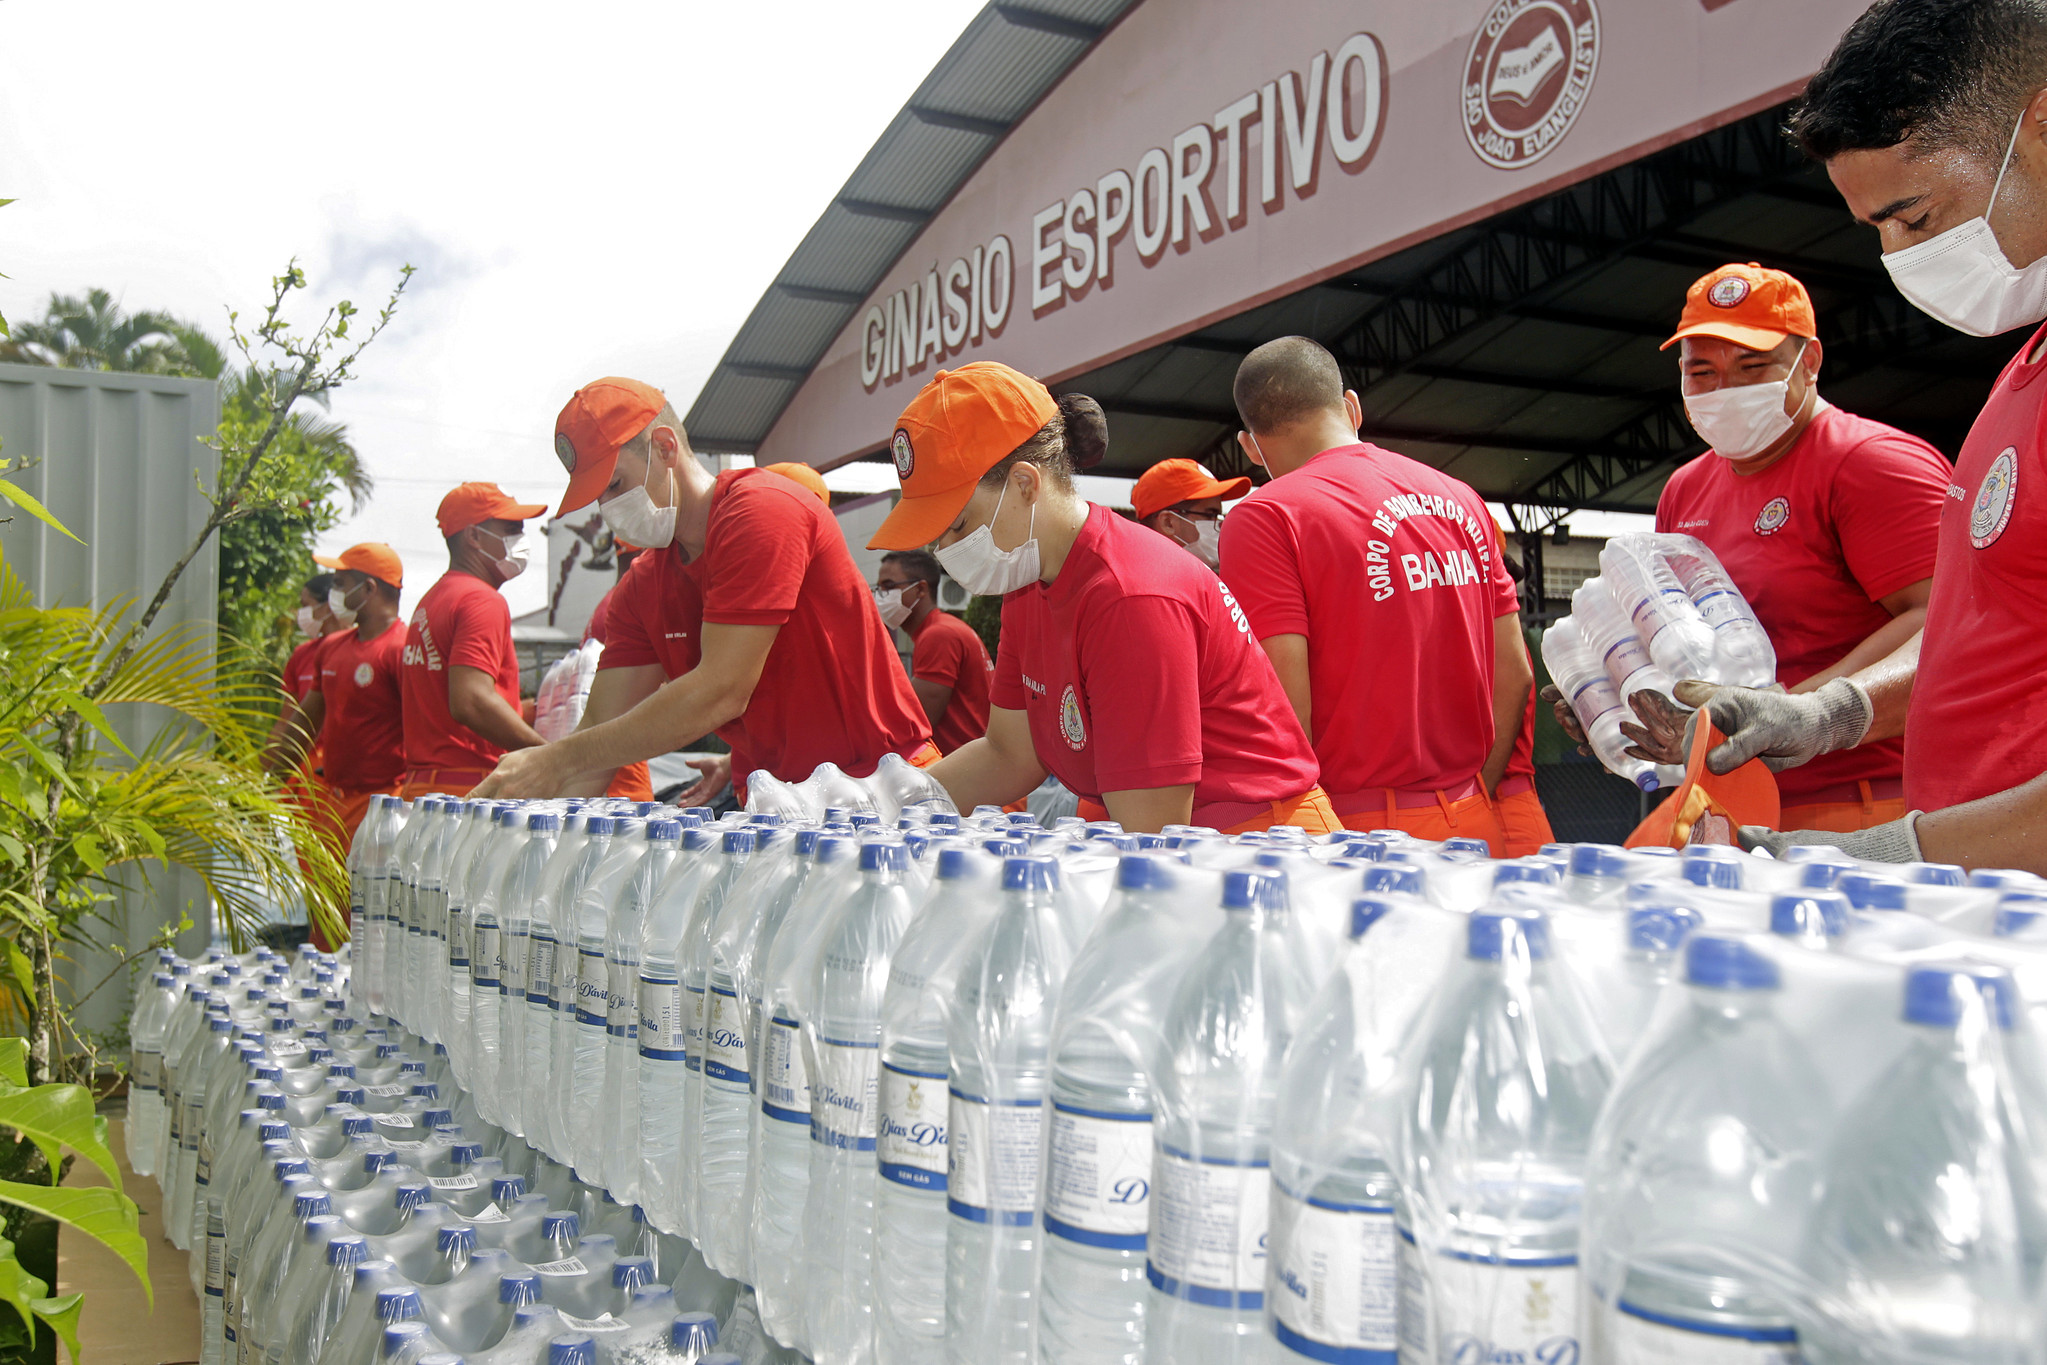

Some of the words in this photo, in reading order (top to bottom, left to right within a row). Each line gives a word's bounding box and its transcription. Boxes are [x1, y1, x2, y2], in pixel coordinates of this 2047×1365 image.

[1522, 20, 1594, 156] EVANGELISTA
[860, 235, 1012, 388] GINÁSIO
[1031, 32, 1382, 312] ESPORTIVO
[1371, 509, 1398, 538] DE
[1382, 493, 1465, 526] BOMBEIROS
[1366, 539, 1395, 602] CORPO
[1400, 549, 1481, 592] BAHIA
[579, 981, 608, 1000] D'ávil
[712, 1028, 747, 1049] D'áv
[880, 1112, 907, 1138] Dias
